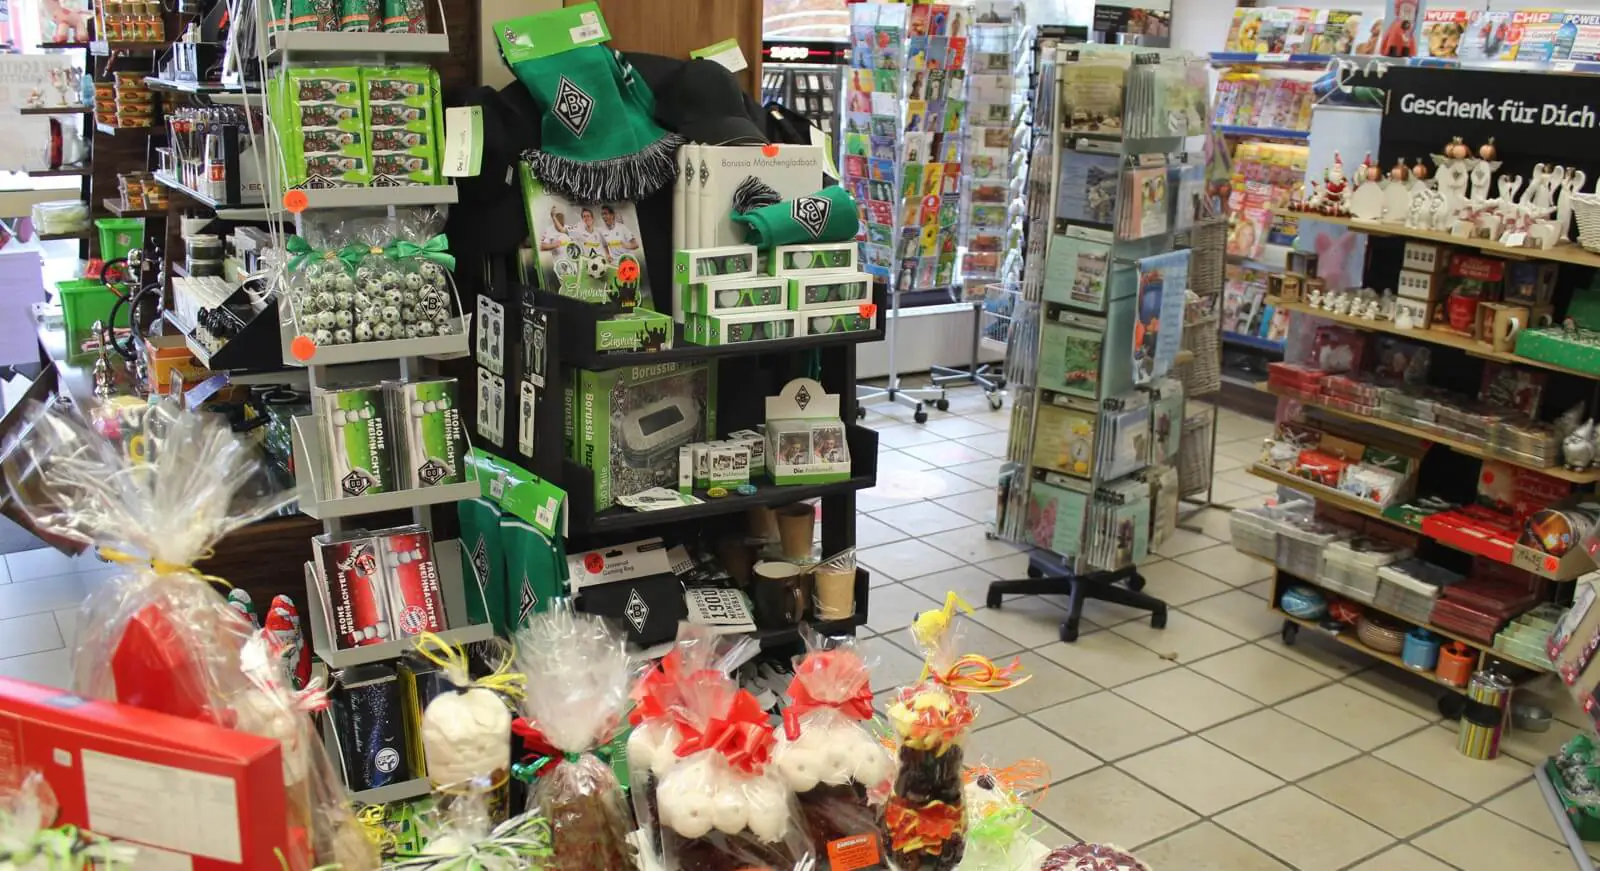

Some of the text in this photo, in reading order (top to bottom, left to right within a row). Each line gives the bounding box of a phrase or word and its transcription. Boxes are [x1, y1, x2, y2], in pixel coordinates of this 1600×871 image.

[1512, 12, 1551, 24] CHIP
[1400, 93, 1595, 129] Geschenk für Dich
[721, 157, 817, 169] Borussia Mönchengladbach
[631, 361, 676, 380] Borussia
[451, 408, 460, 440] FROHE
[564, 388, 574, 436] Borussia
[585, 394, 595, 441] Borussia
[375, 417, 384, 450] FROHE
[443, 409, 456, 477] WEIHNACHTEN
[367, 418, 381, 487] WEIHNACHTEN
[426, 561, 438, 592] FROHE
[338, 571, 354, 633] WEIHNACHTEN
[418, 563, 438, 628] WEIHNACHTEN
[701, 590, 728, 619] 1900
[337, 606, 347, 635] FROHE
